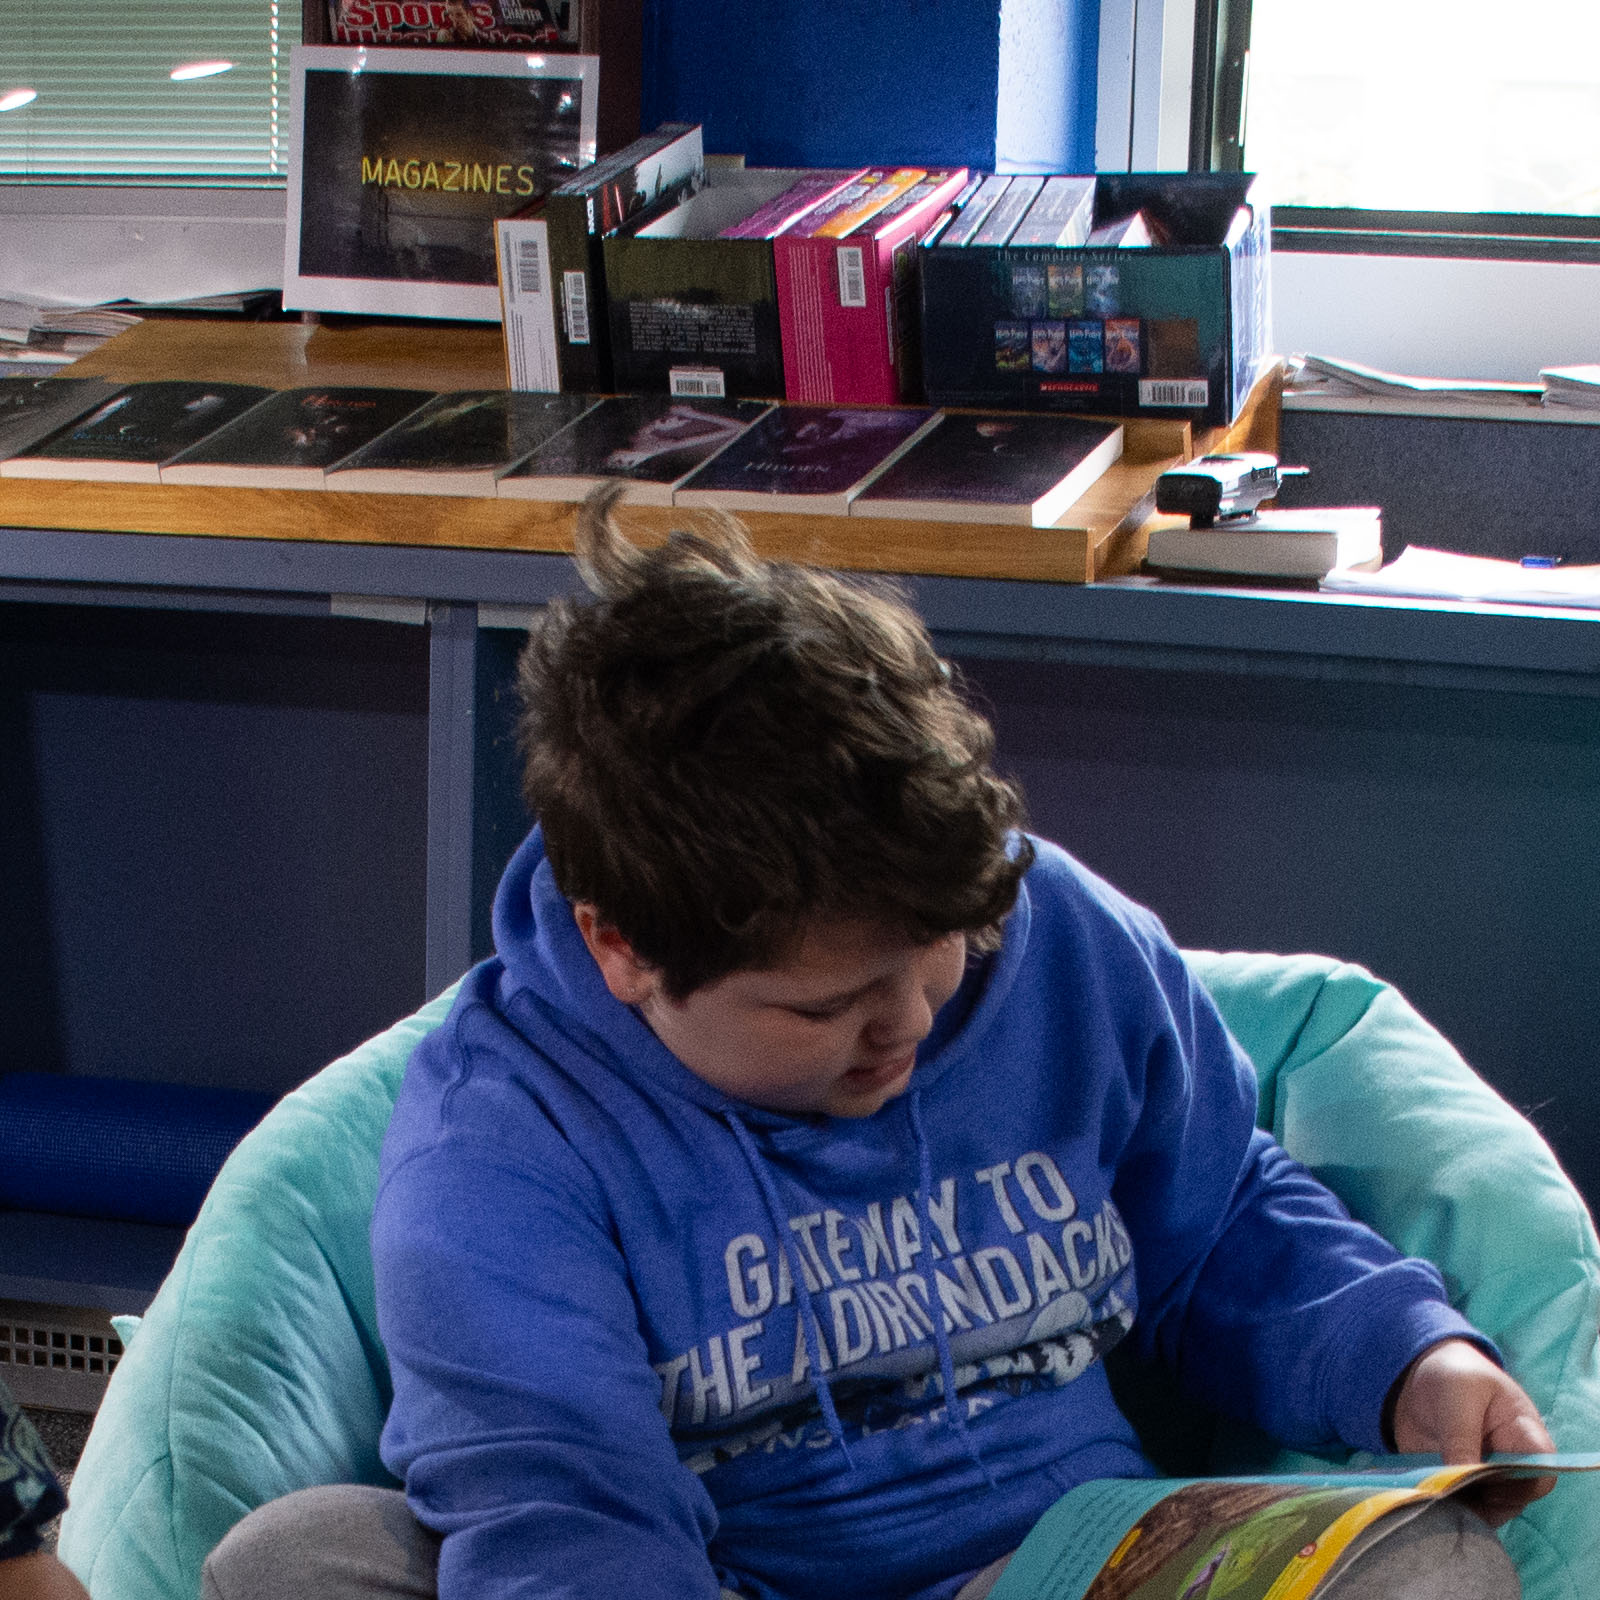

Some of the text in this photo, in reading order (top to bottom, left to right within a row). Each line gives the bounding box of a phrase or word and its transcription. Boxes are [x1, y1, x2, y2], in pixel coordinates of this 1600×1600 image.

[345, 0, 496, 31] Spors
[501, 7, 543, 23] CHAPTER
[360, 156, 536, 196] MAGAZINES
[996, 250, 1133, 264] The Complete Series
[975, 1151, 1077, 1235] TO
[655, 1198, 1134, 1430] THE ADIRONDACKS
